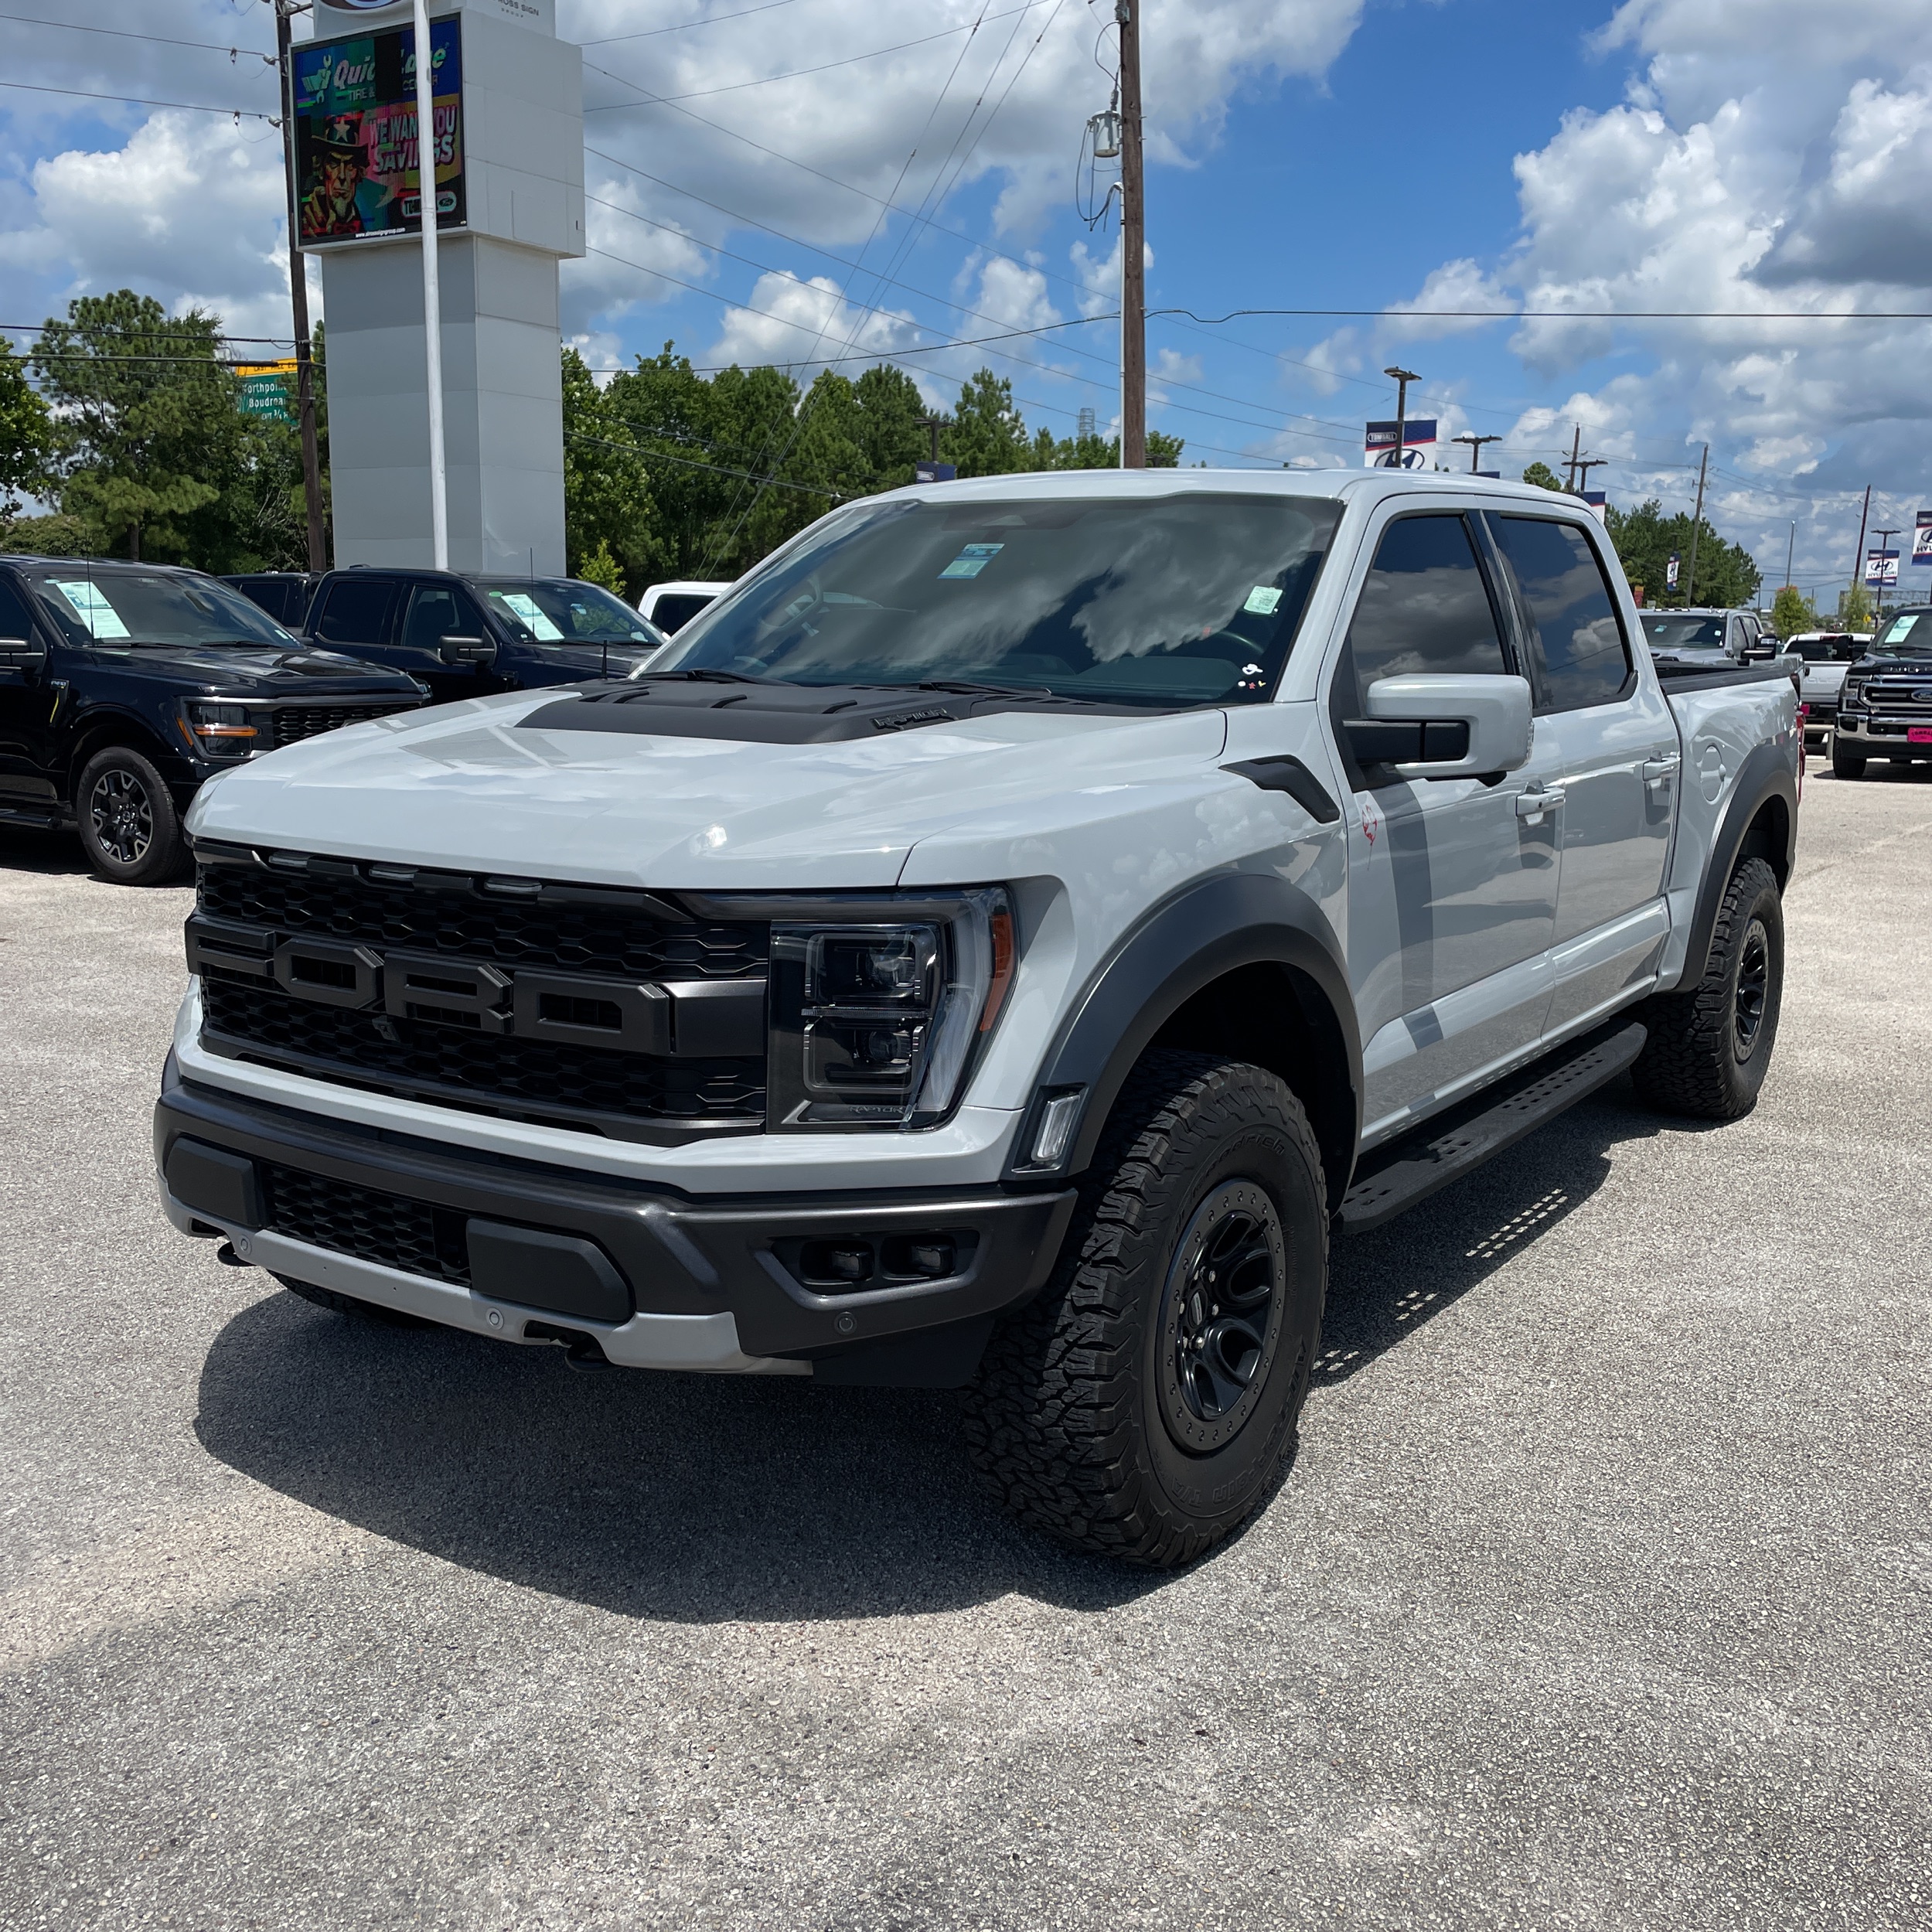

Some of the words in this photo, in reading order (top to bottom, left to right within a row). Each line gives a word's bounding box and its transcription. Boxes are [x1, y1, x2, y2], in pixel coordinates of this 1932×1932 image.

[333, 55, 376, 90] Quic
[870, 707, 959, 731] RAPTOR
[185, 914, 671, 1056] FORD
[850, 1106, 905, 1114] RAPTOR
